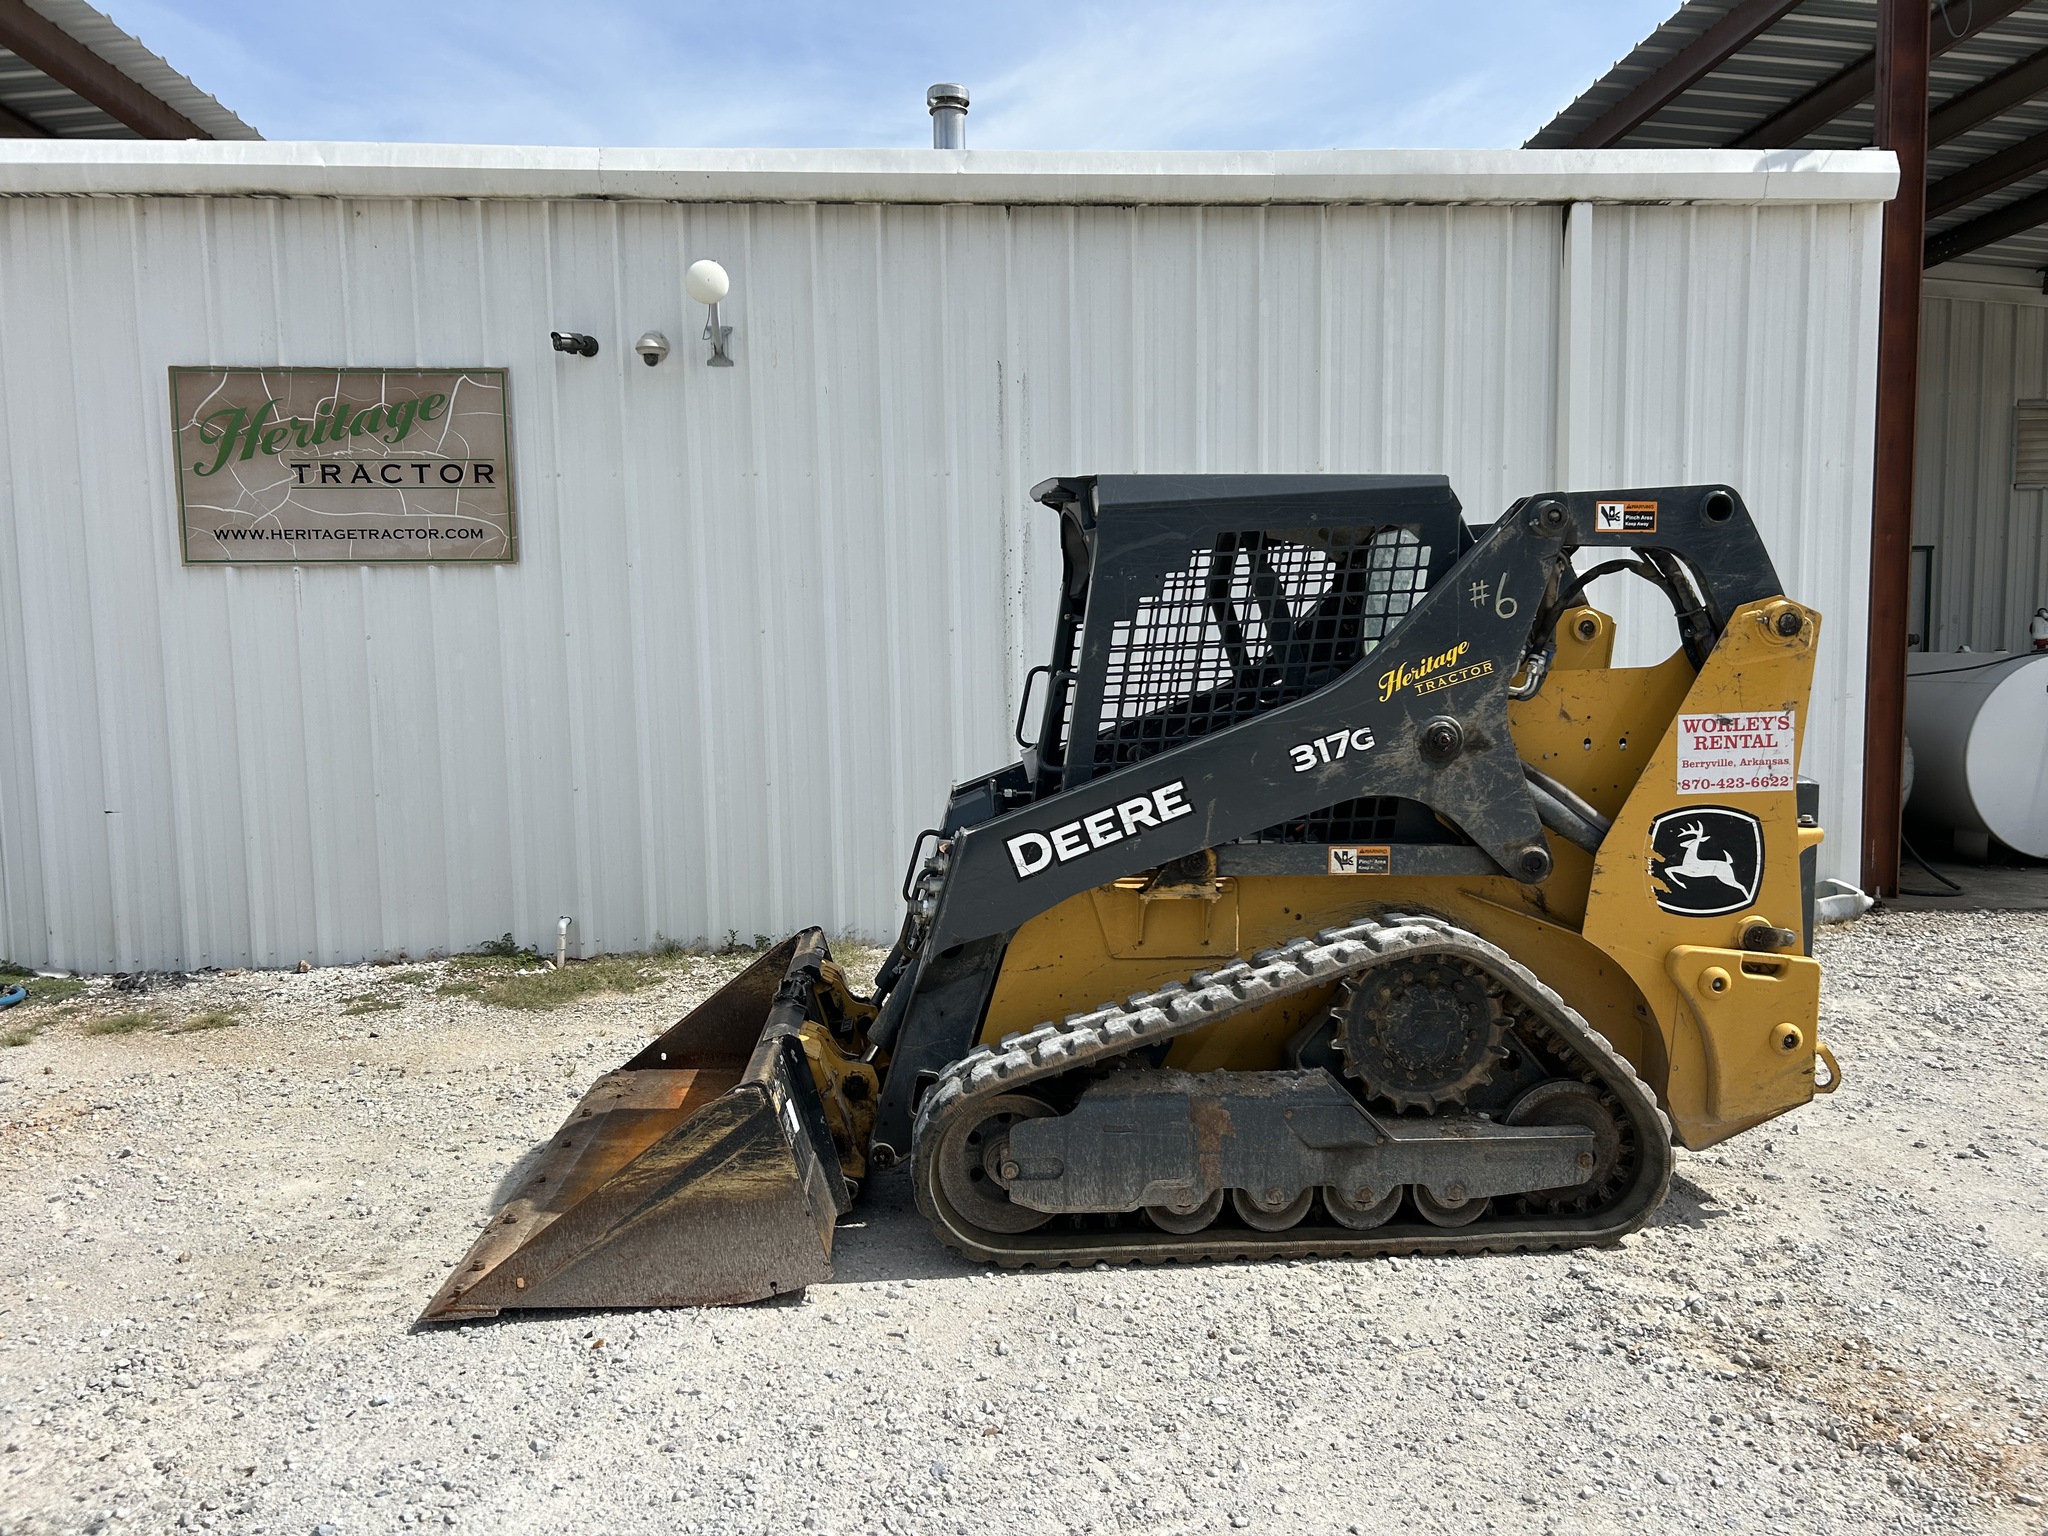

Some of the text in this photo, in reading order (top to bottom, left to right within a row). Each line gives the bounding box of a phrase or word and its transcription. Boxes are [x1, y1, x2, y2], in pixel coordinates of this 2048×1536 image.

[193, 393, 450, 476] Heritage
[291, 463, 495, 484] TRACTOR
[213, 527, 484, 540] WWW.HERITAGETRACTOR.COM
[1379, 641, 1470, 702] Heritage
[1415, 662, 1493, 693] TRACTOR
[1289, 728, 1375, 772] 317G
[1694, 733, 1778, 751] RENTAL
[1682, 757, 1790, 769] Berryville, Arkansas
[1681, 776, 1789, 791] 870-423-6622
[1007, 781, 1192, 878] DEERE
